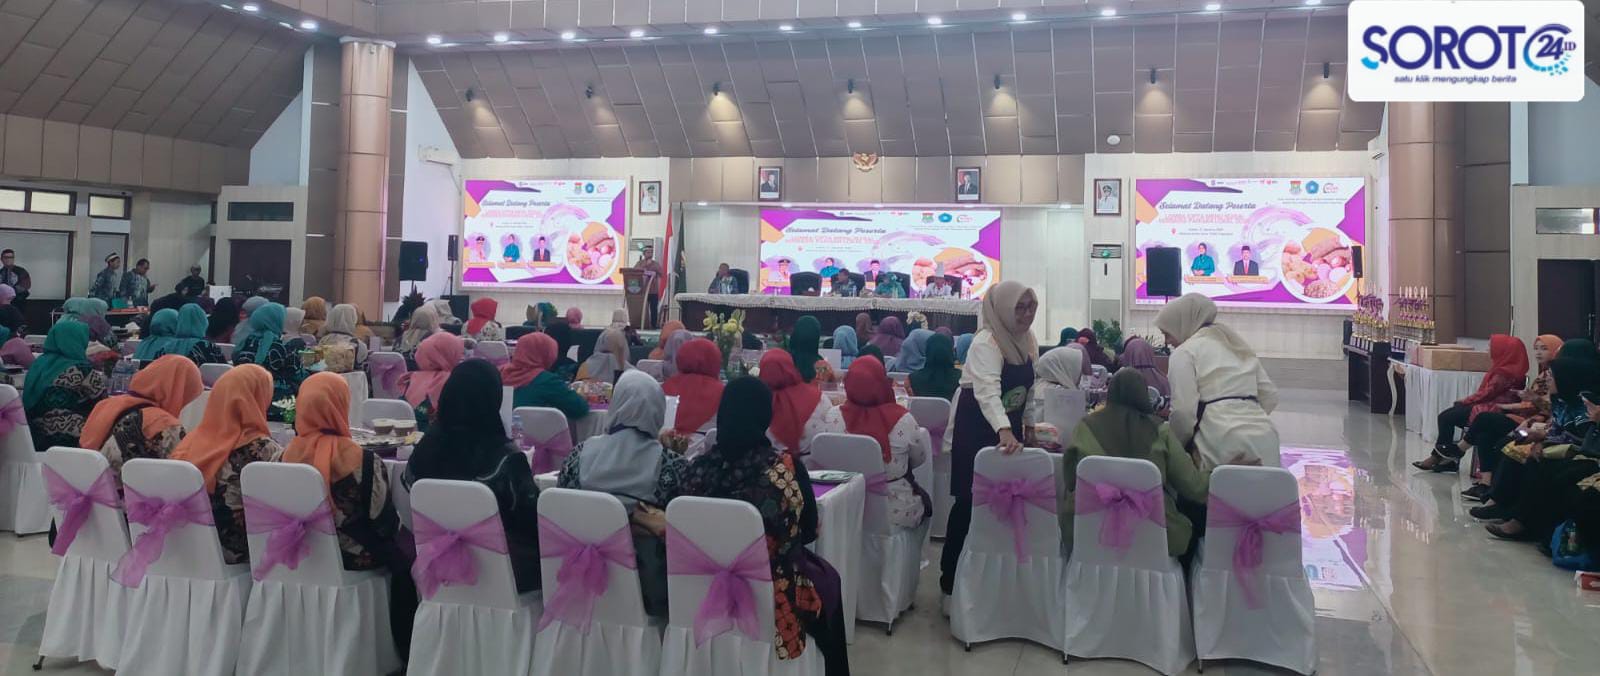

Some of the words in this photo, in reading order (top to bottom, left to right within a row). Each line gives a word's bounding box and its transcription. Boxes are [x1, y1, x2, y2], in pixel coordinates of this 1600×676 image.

[1159, 202, 1192, 210] Selamat
[1193, 201, 1223, 212] Datang
[1225, 201, 1257, 210] Peserta
